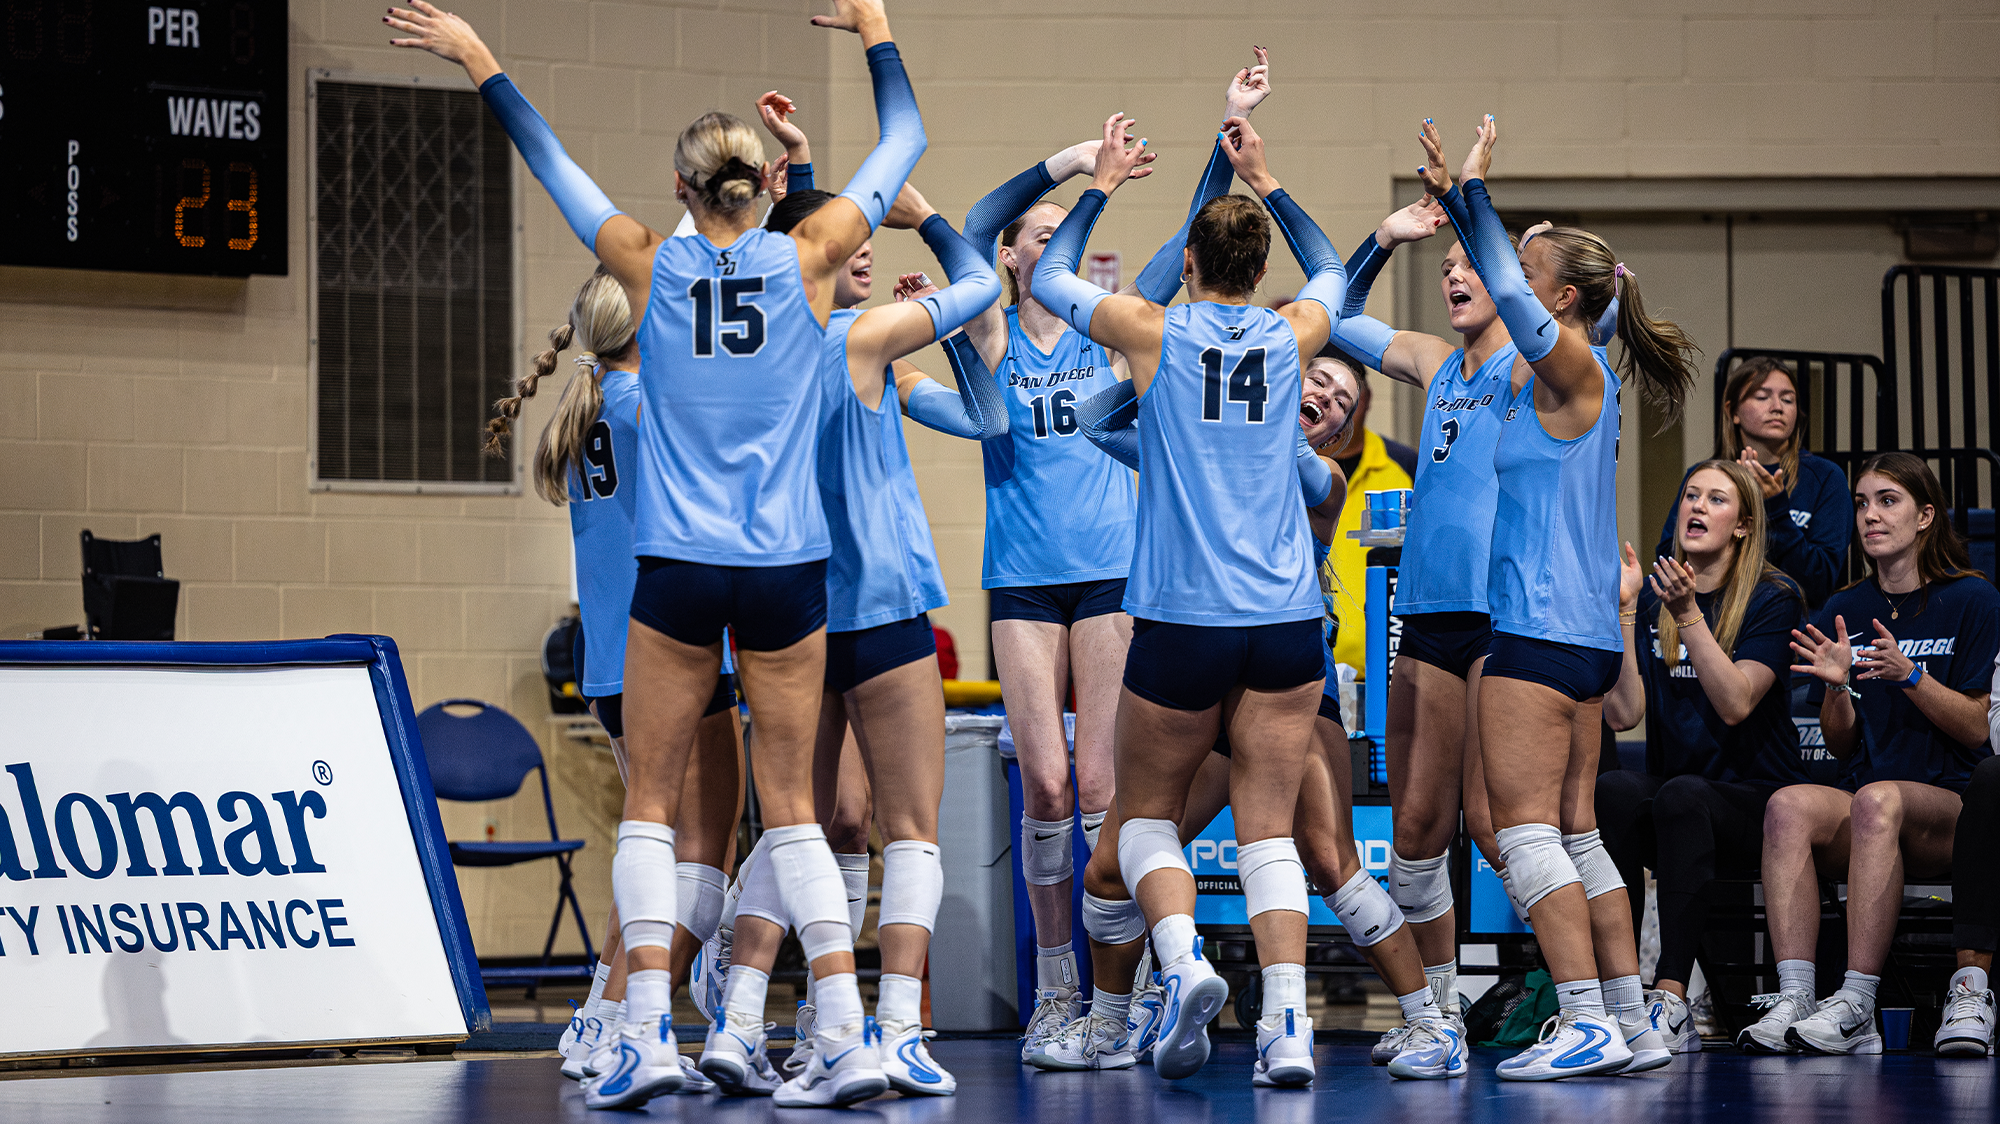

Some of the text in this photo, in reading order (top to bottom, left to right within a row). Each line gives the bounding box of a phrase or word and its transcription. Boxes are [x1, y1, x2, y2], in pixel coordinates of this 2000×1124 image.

[147, 6, 200, 49] PER
[167, 95, 262, 141] WAVES
[66, 139, 81, 243] POSS
[174, 158, 259, 250] 23
[687, 276, 768, 359] 15
[1007, 365, 1095, 389] SAN DIEGO
[1198, 345, 1270, 424] 14
[1028, 387, 1080, 439] 16
[1431, 417, 1461, 463] 3
[1197, 881, 1240, 890] OFFICIAL
[56, 898, 356, 955] INSURANCE
